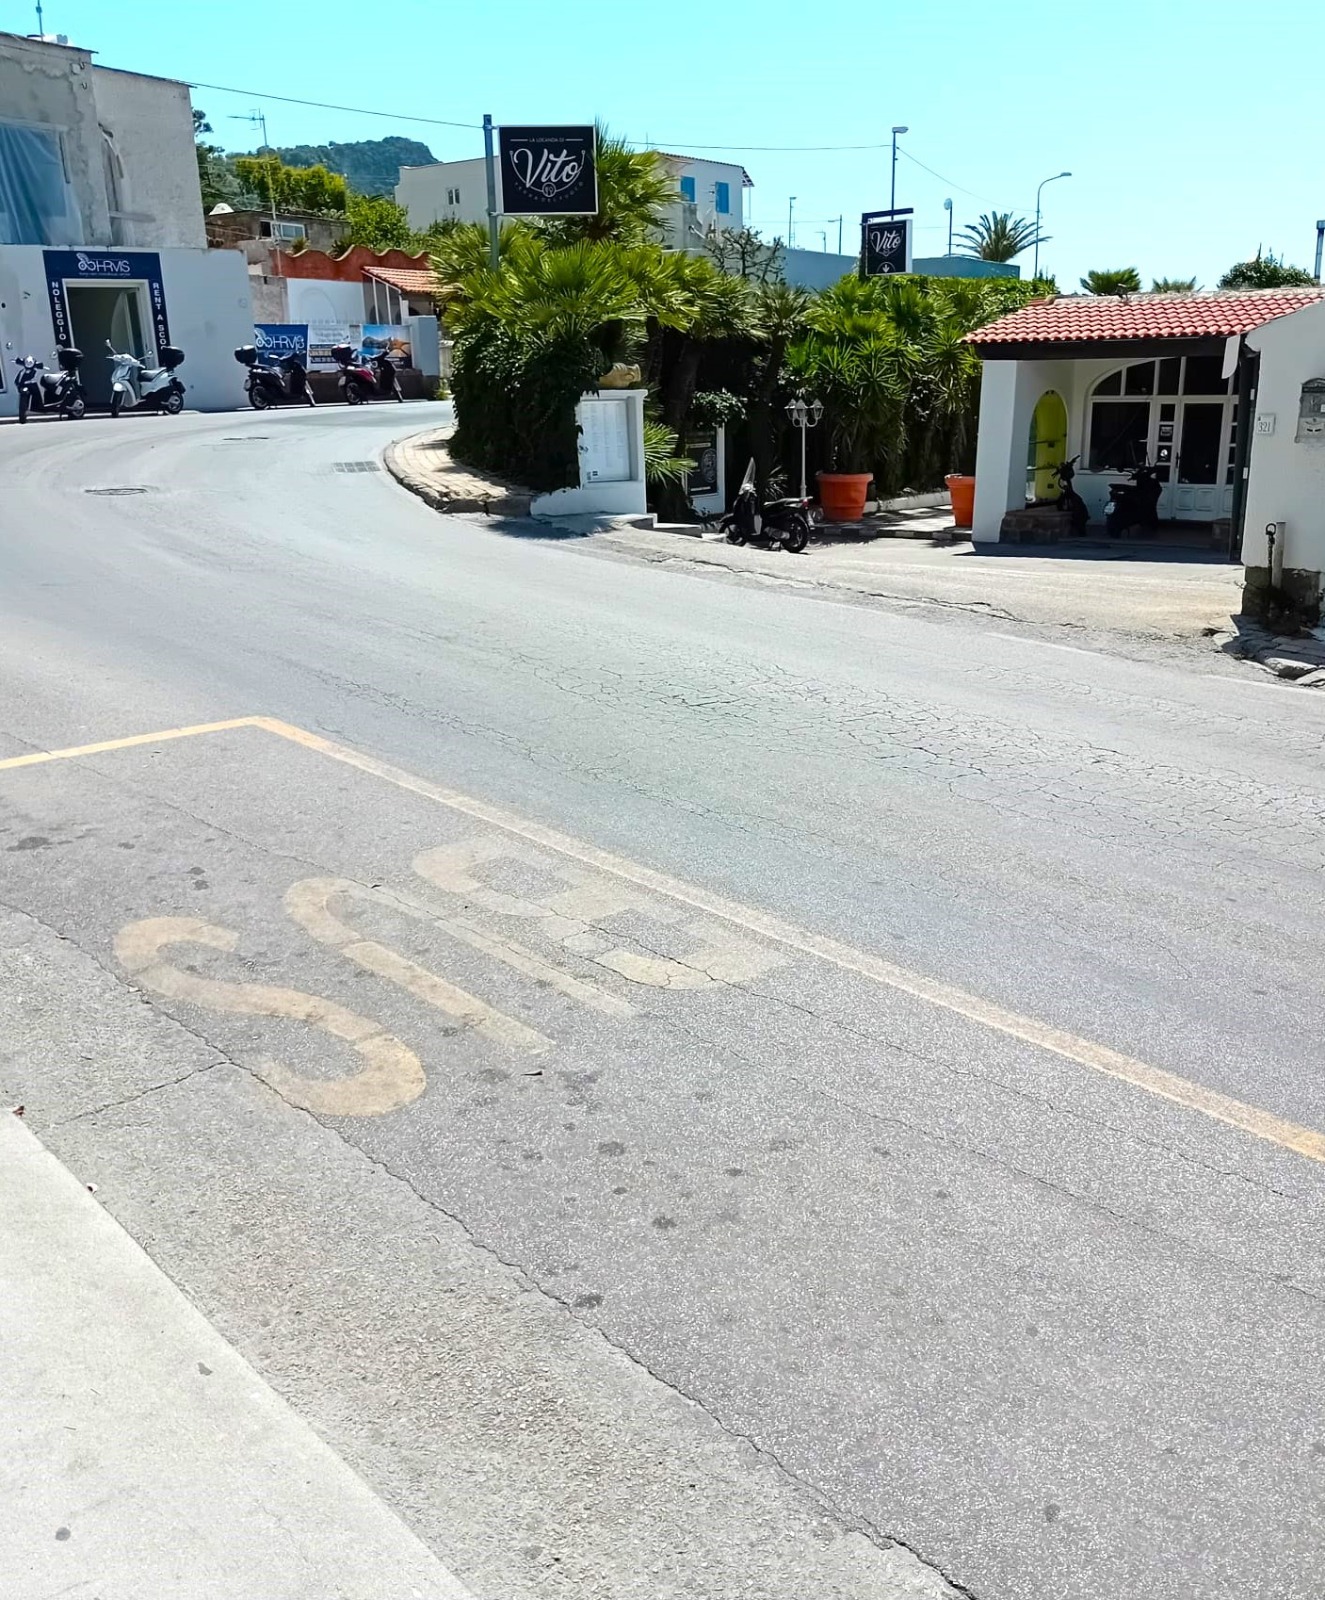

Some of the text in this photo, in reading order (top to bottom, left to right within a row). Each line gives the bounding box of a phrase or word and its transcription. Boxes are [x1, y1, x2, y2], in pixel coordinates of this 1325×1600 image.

[513, 148, 578, 188] Vito
[871, 230, 901, 253] Vito
[52, 281, 66, 340] NOLEGGIO
[152, 282, 161, 310] RENT
